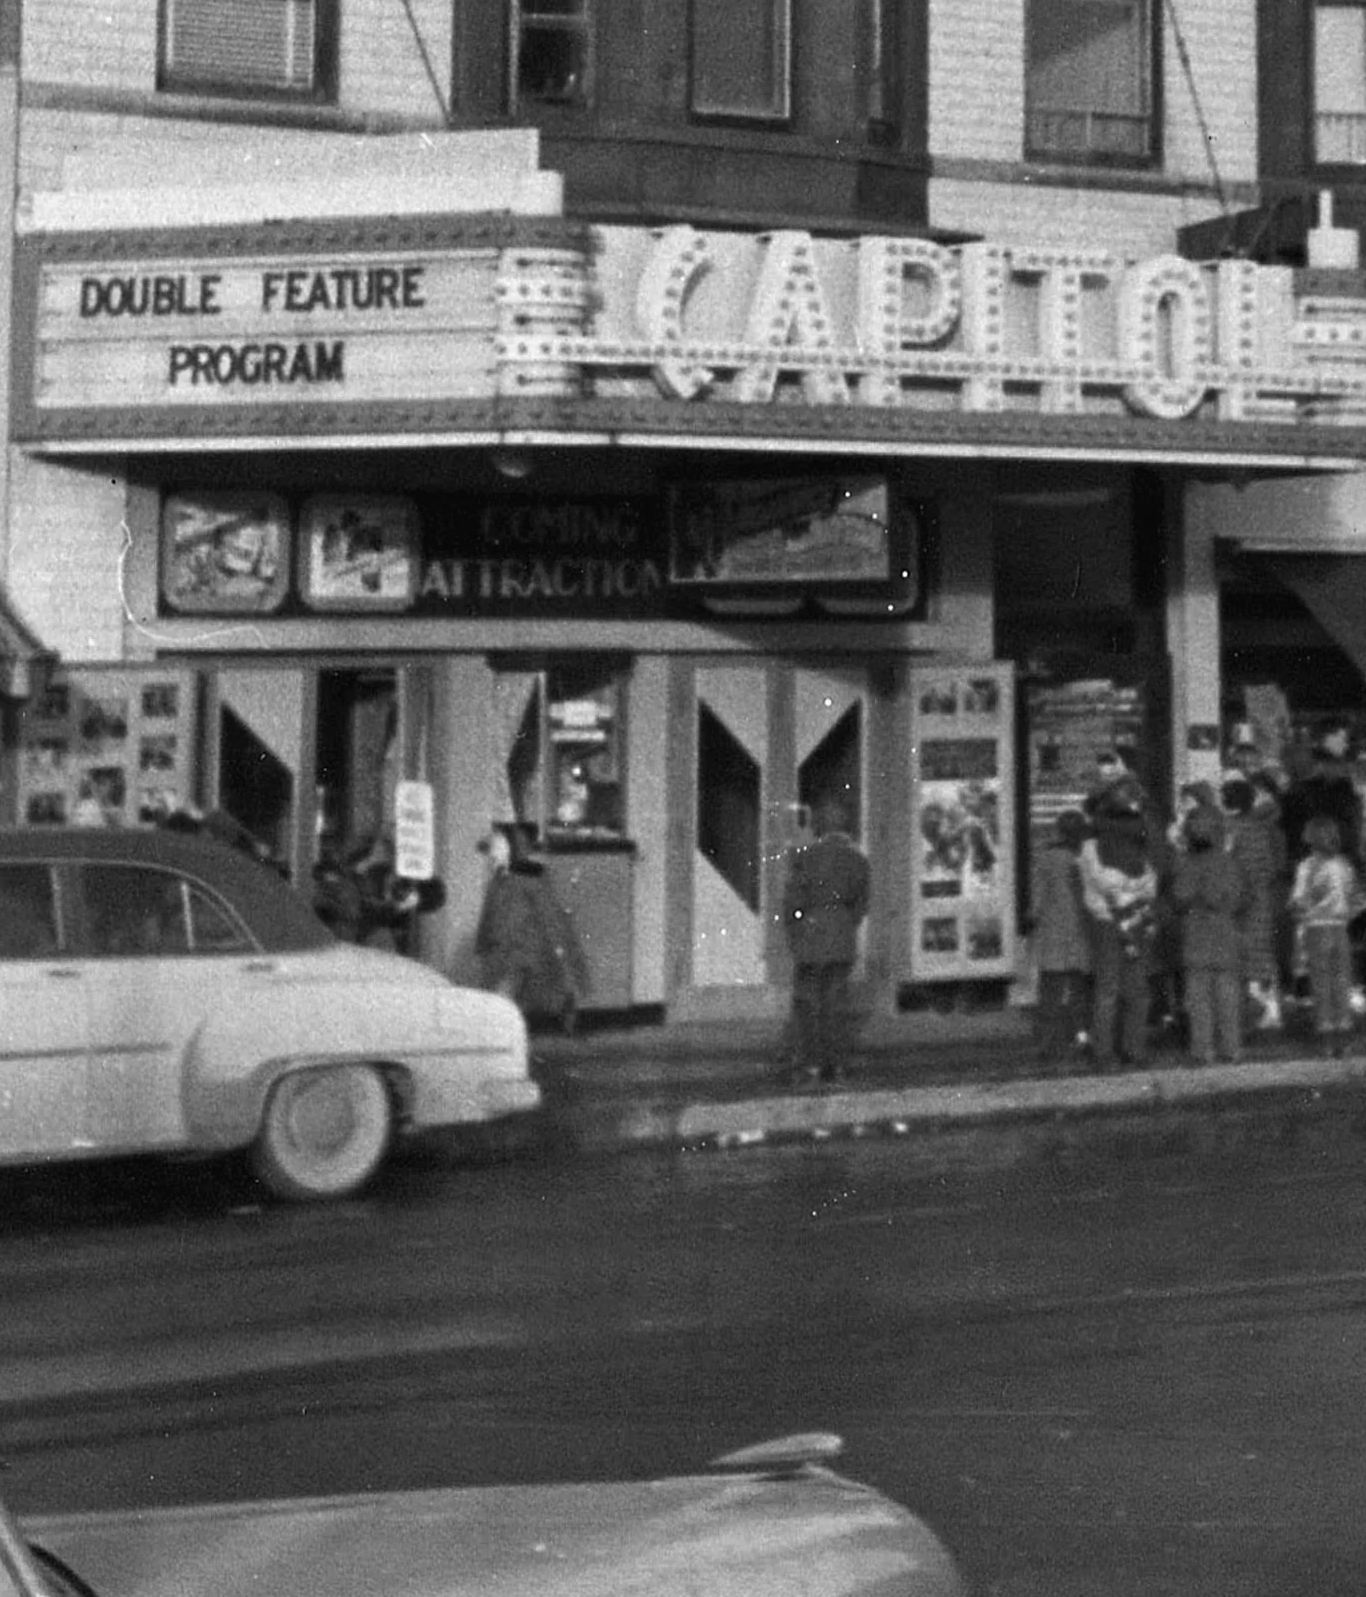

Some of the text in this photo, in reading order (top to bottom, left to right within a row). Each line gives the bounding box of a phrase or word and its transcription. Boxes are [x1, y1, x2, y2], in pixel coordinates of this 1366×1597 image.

[80, 267, 425, 318] DOUBLE FEATURE
[640, 224, 1297, 424] CAPITOL
[168, 341, 344, 386] PROGRAM
